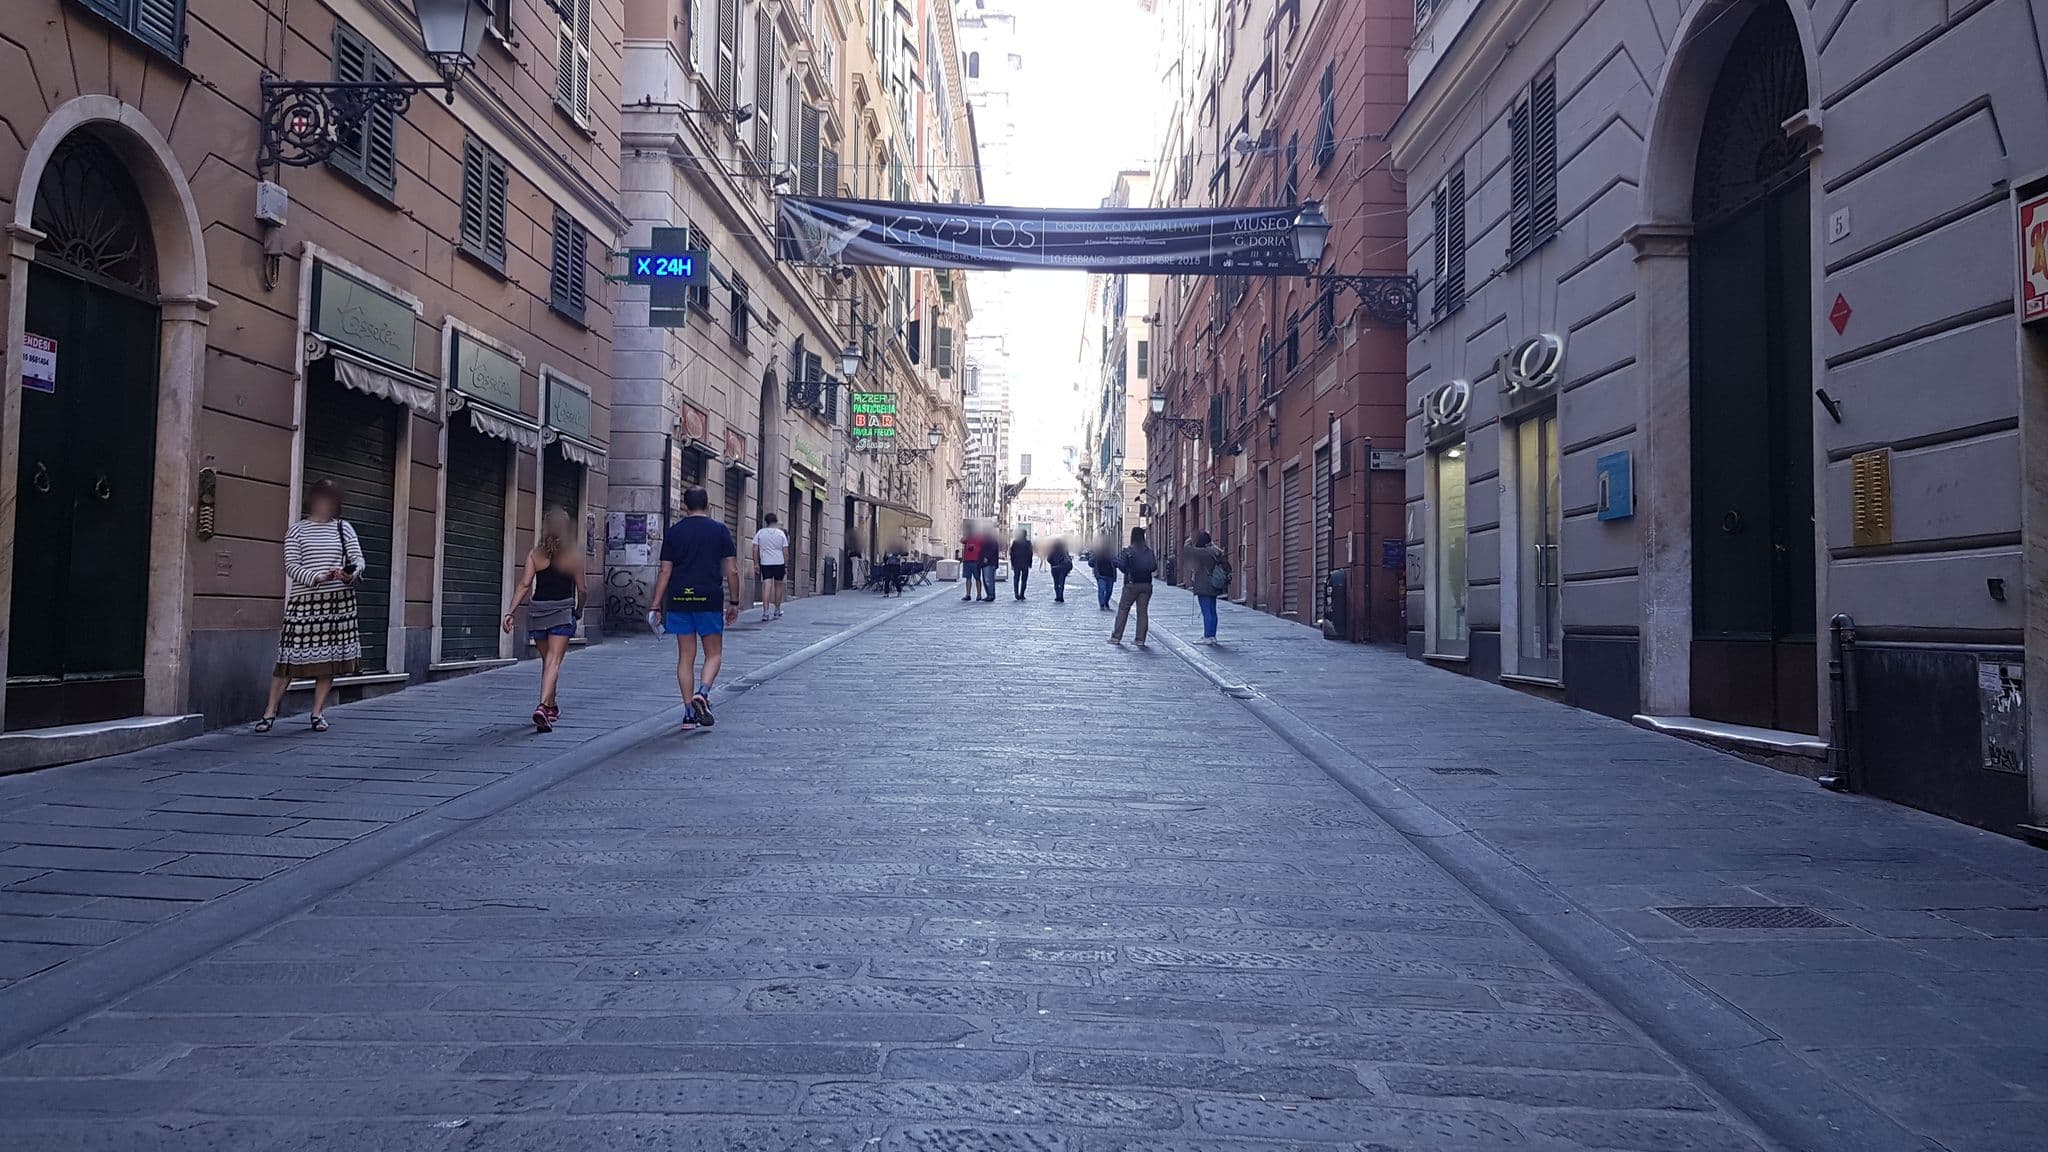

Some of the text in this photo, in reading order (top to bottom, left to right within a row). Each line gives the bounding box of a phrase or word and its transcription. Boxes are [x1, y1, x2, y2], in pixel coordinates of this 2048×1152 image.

[1055, 222, 1200, 232] MOSTRA CON ANIMALI VIVI
[1233, 217, 1289, 231] MUSEO
[1835, 215, 1843, 235] 5
[1050, 255, 1106, 264] 10 FEBBRAIO
[1119, 255, 1125, 265] 2
[1126, 255, 1174, 265] SETTEMBRE
[637, 257, 692, 276] X 24H
[23, 335, 51, 351] ENDESI
[855, 414, 893, 427] BAR
